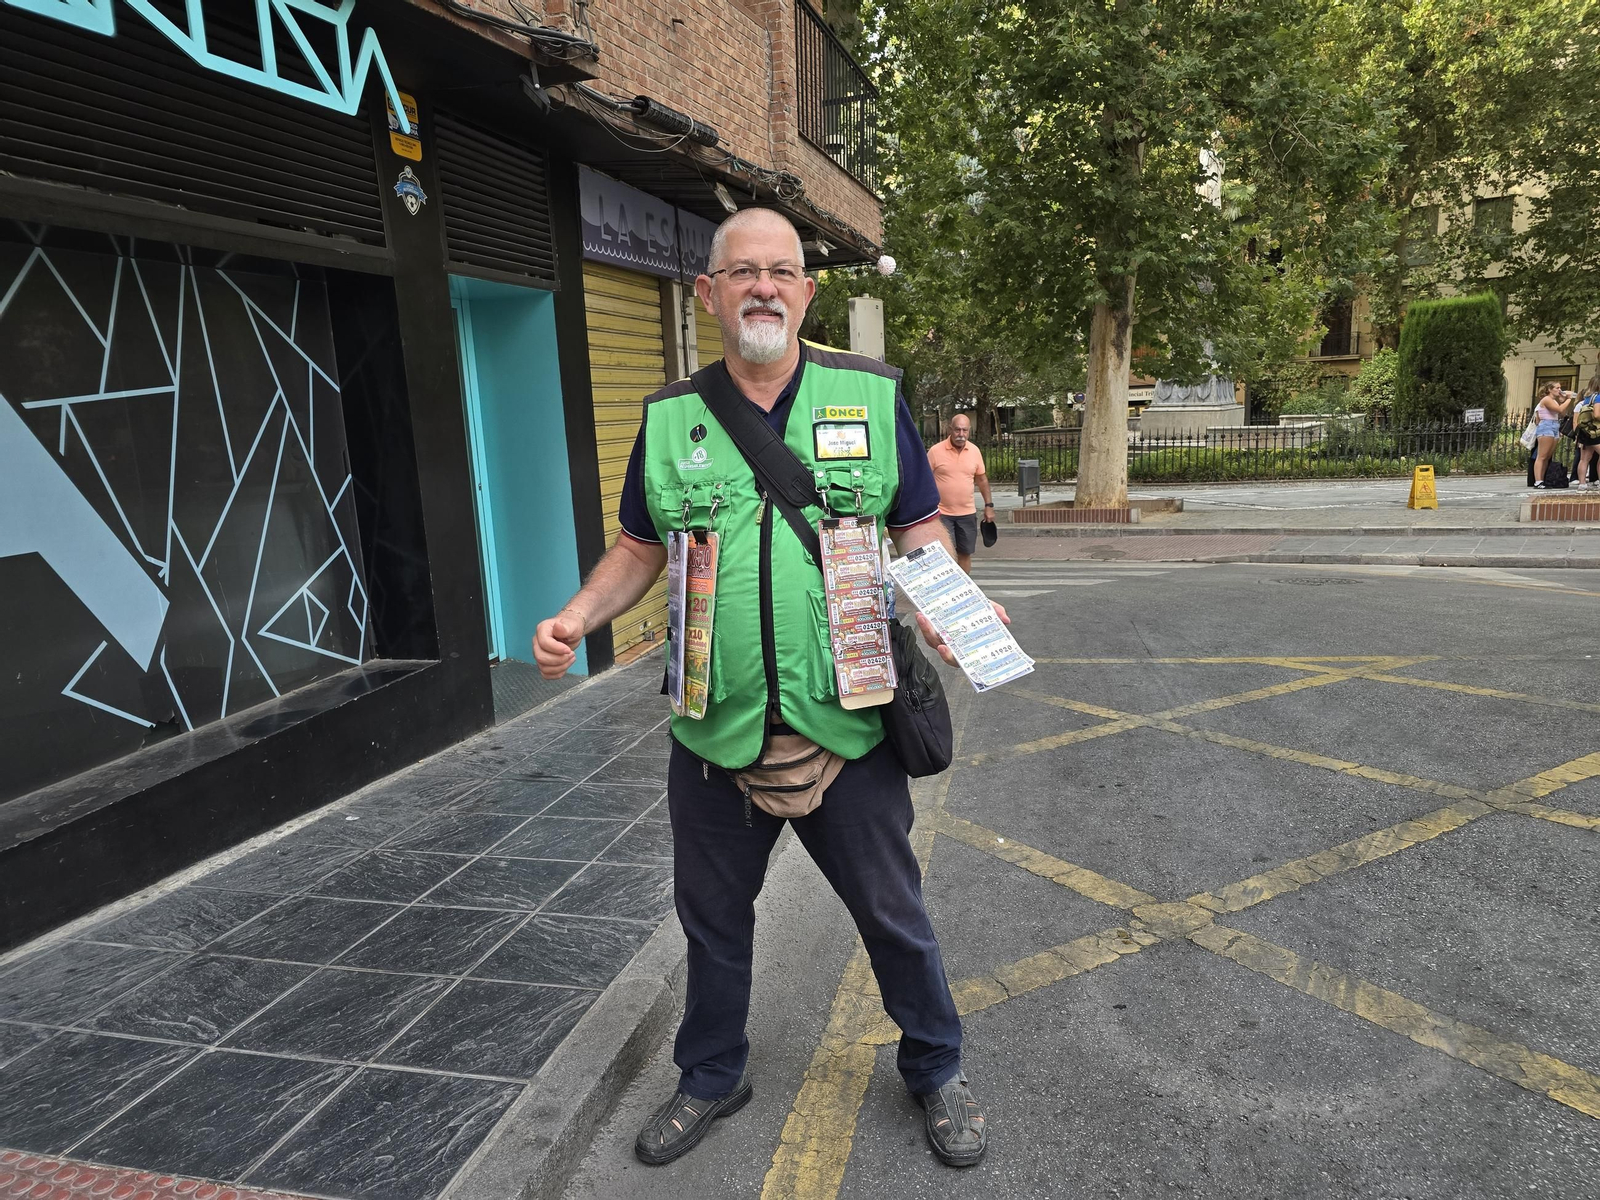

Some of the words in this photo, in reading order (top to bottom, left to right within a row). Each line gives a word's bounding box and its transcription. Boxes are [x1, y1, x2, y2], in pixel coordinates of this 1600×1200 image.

[598, 193, 632, 247] LA
[645, 211, 713, 267] ESQUI
[829, 408, 864, 418] ONCE
[862, 622, 881, 630] 02420
[867, 656, 886, 665] 02420
[744, 799, 752, 820] ROCK
